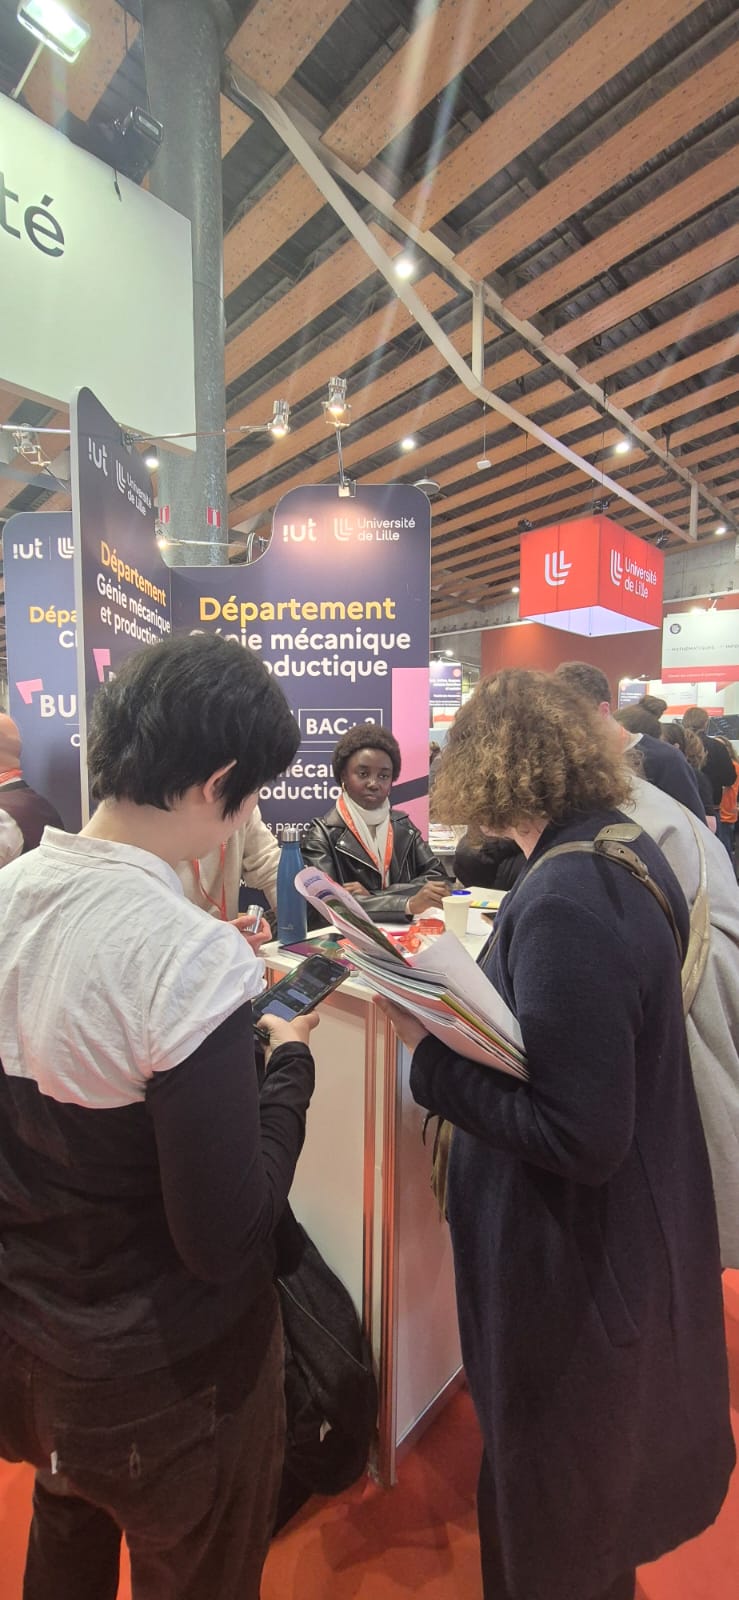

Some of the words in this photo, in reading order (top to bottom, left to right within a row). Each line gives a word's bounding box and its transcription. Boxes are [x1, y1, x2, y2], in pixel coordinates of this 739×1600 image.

[126, 471, 152, 508] Université
[127, 489, 136, 505] de
[135, 495, 147, 516] Lille
[357, 516, 416, 529] Université
[357, 530, 371, 541] de
[375, 530, 400, 541] Lille
[101, 540, 167, 607] Département
[625, 555, 657, 585] Université
[624, 577, 634, 591] de
[635, 581, 649, 599] Lille
[96, 572, 128, 608] Génie
[129, 597, 171, 634] mécanique
[100, 606, 112, 626] et
[199, 596, 396, 628] Département
[271, 627, 411, 655] mécanique
[263, 655, 388, 682] oductique
